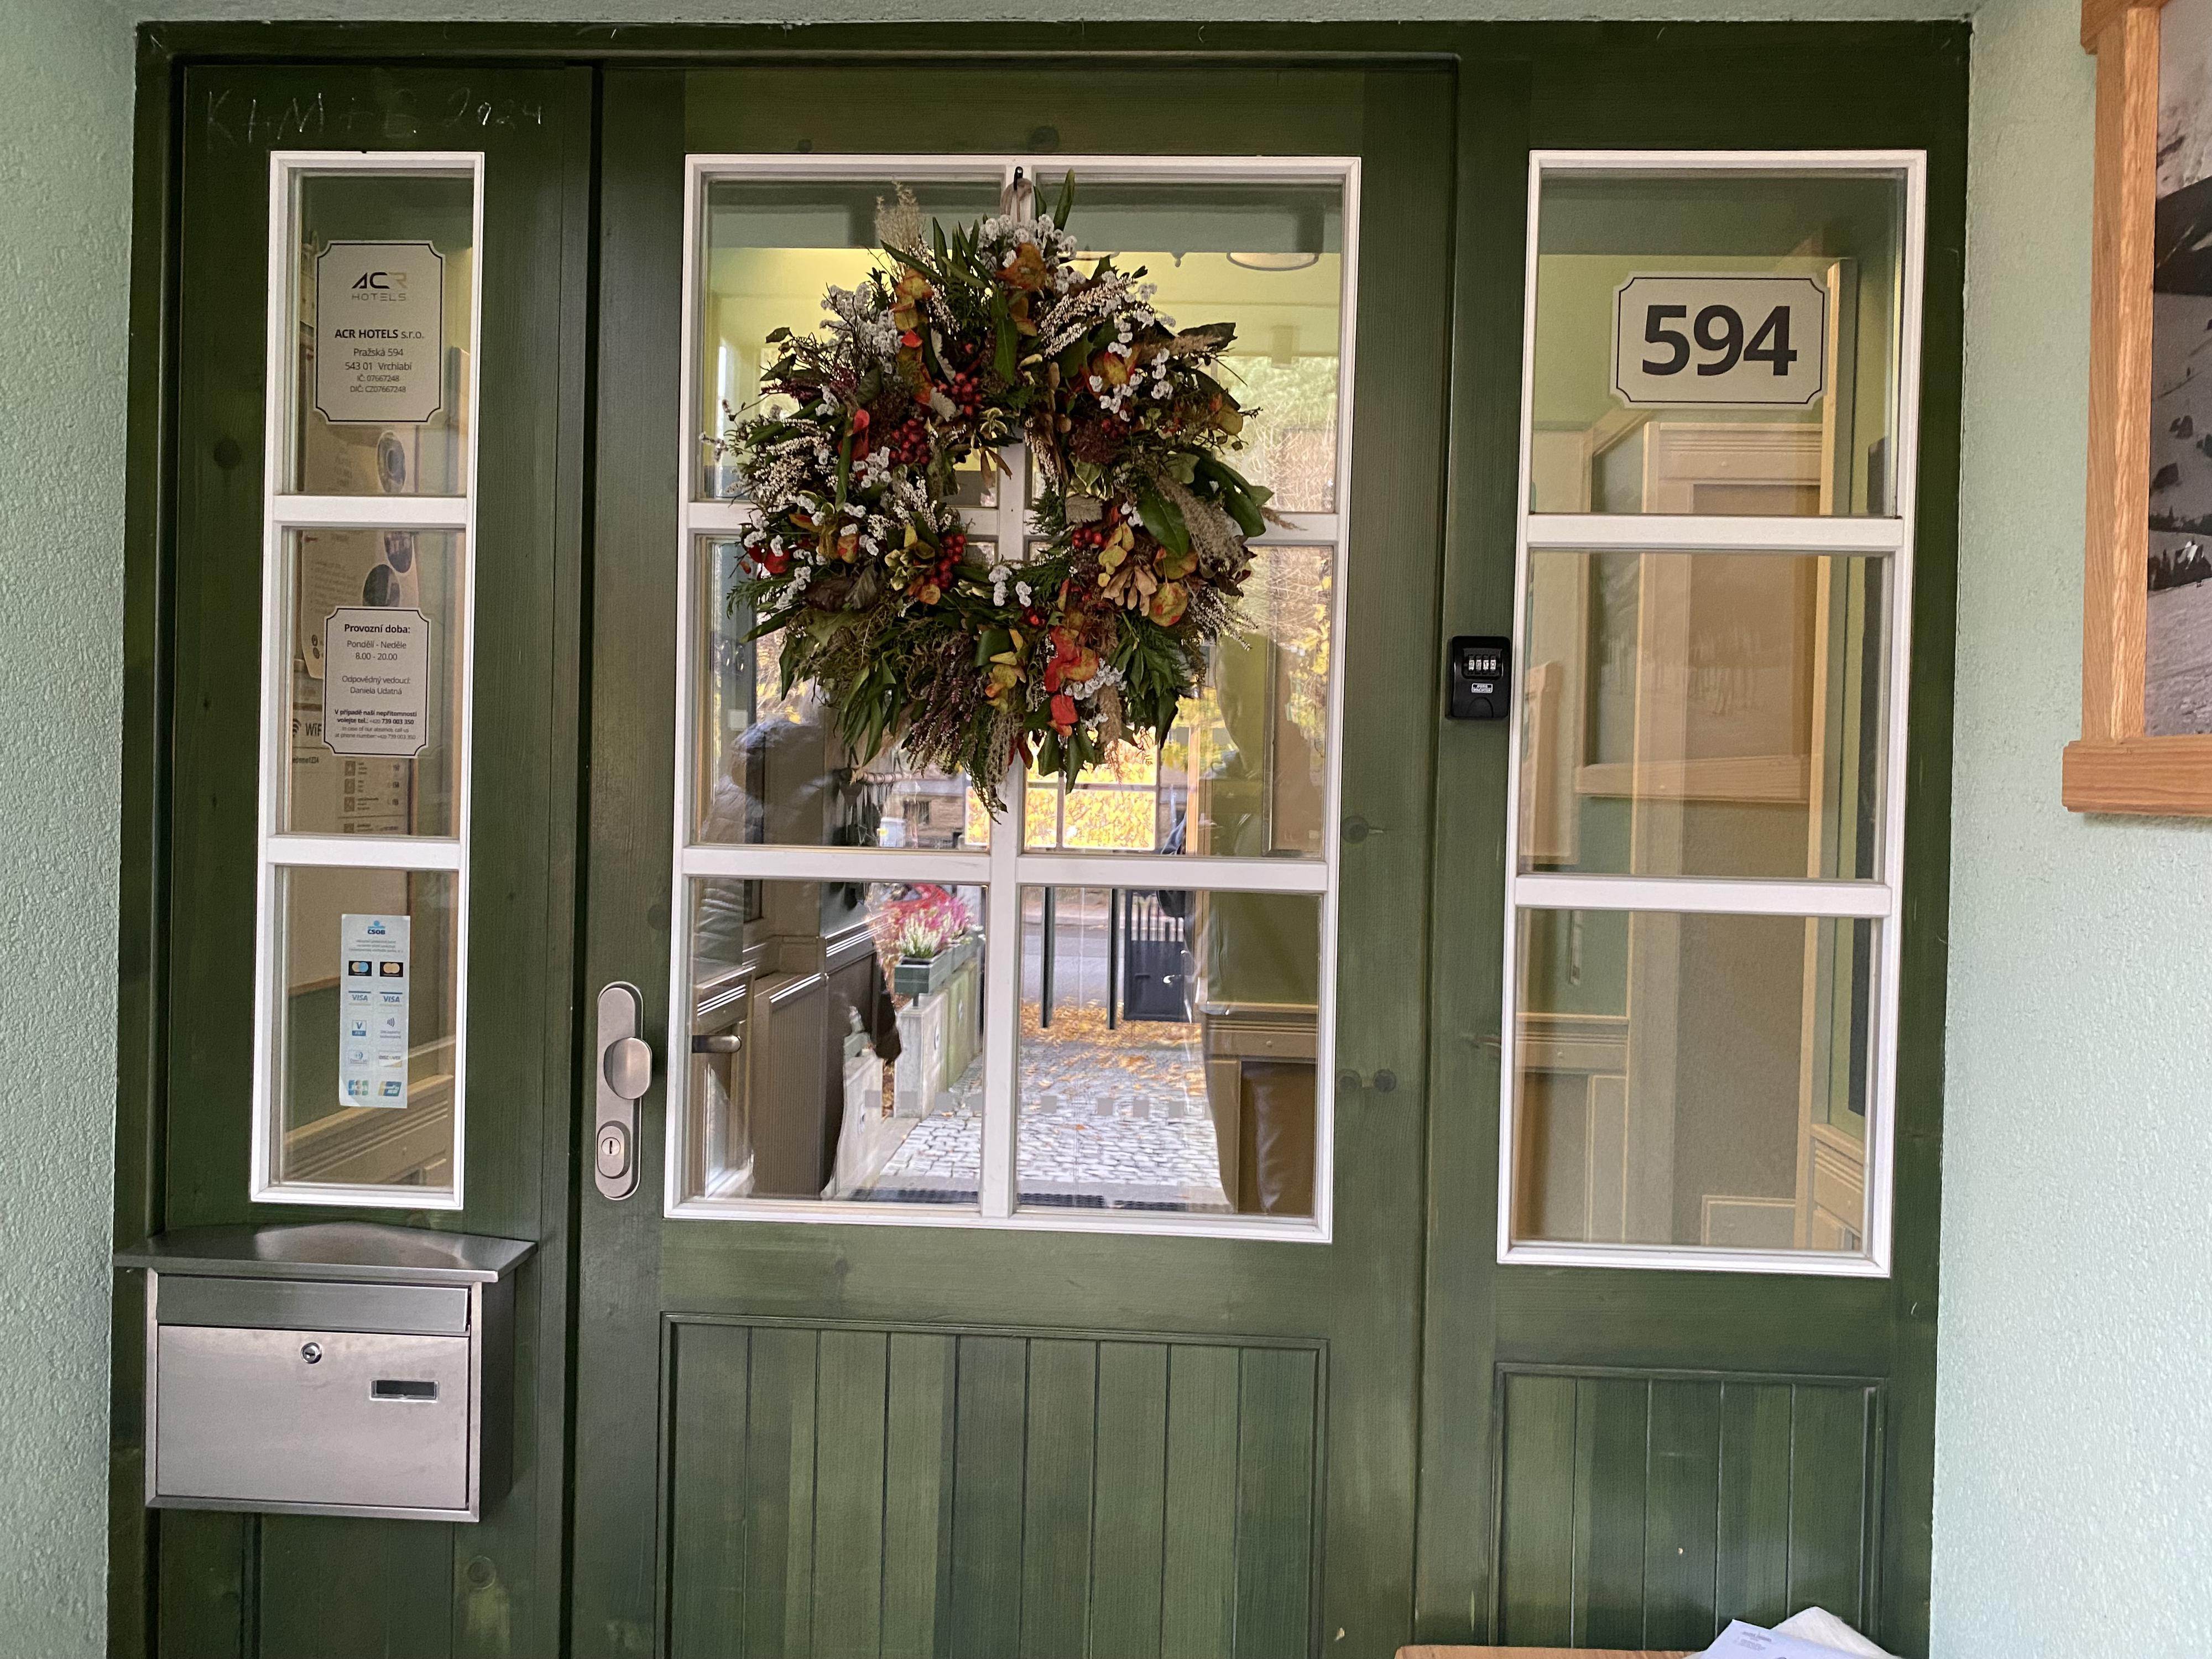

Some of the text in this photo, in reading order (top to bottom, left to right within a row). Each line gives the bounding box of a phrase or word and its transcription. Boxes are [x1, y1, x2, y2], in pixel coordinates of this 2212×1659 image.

[351, 272, 408, 289] ACR
[335, 330, 424, 339] ACR HOTELS s.r.o.
[1642, 305, 1797, 375] 594
[354, 348, 385, 357] Pražská
[345, 362, 361, 371] 543
[363, 362, 372, 371] 01
[344, 624, 410, 634] Provozní doba:
[347, 640, 374, 648] Pondělí
[342, 676, 382, 685] Odpovědný
